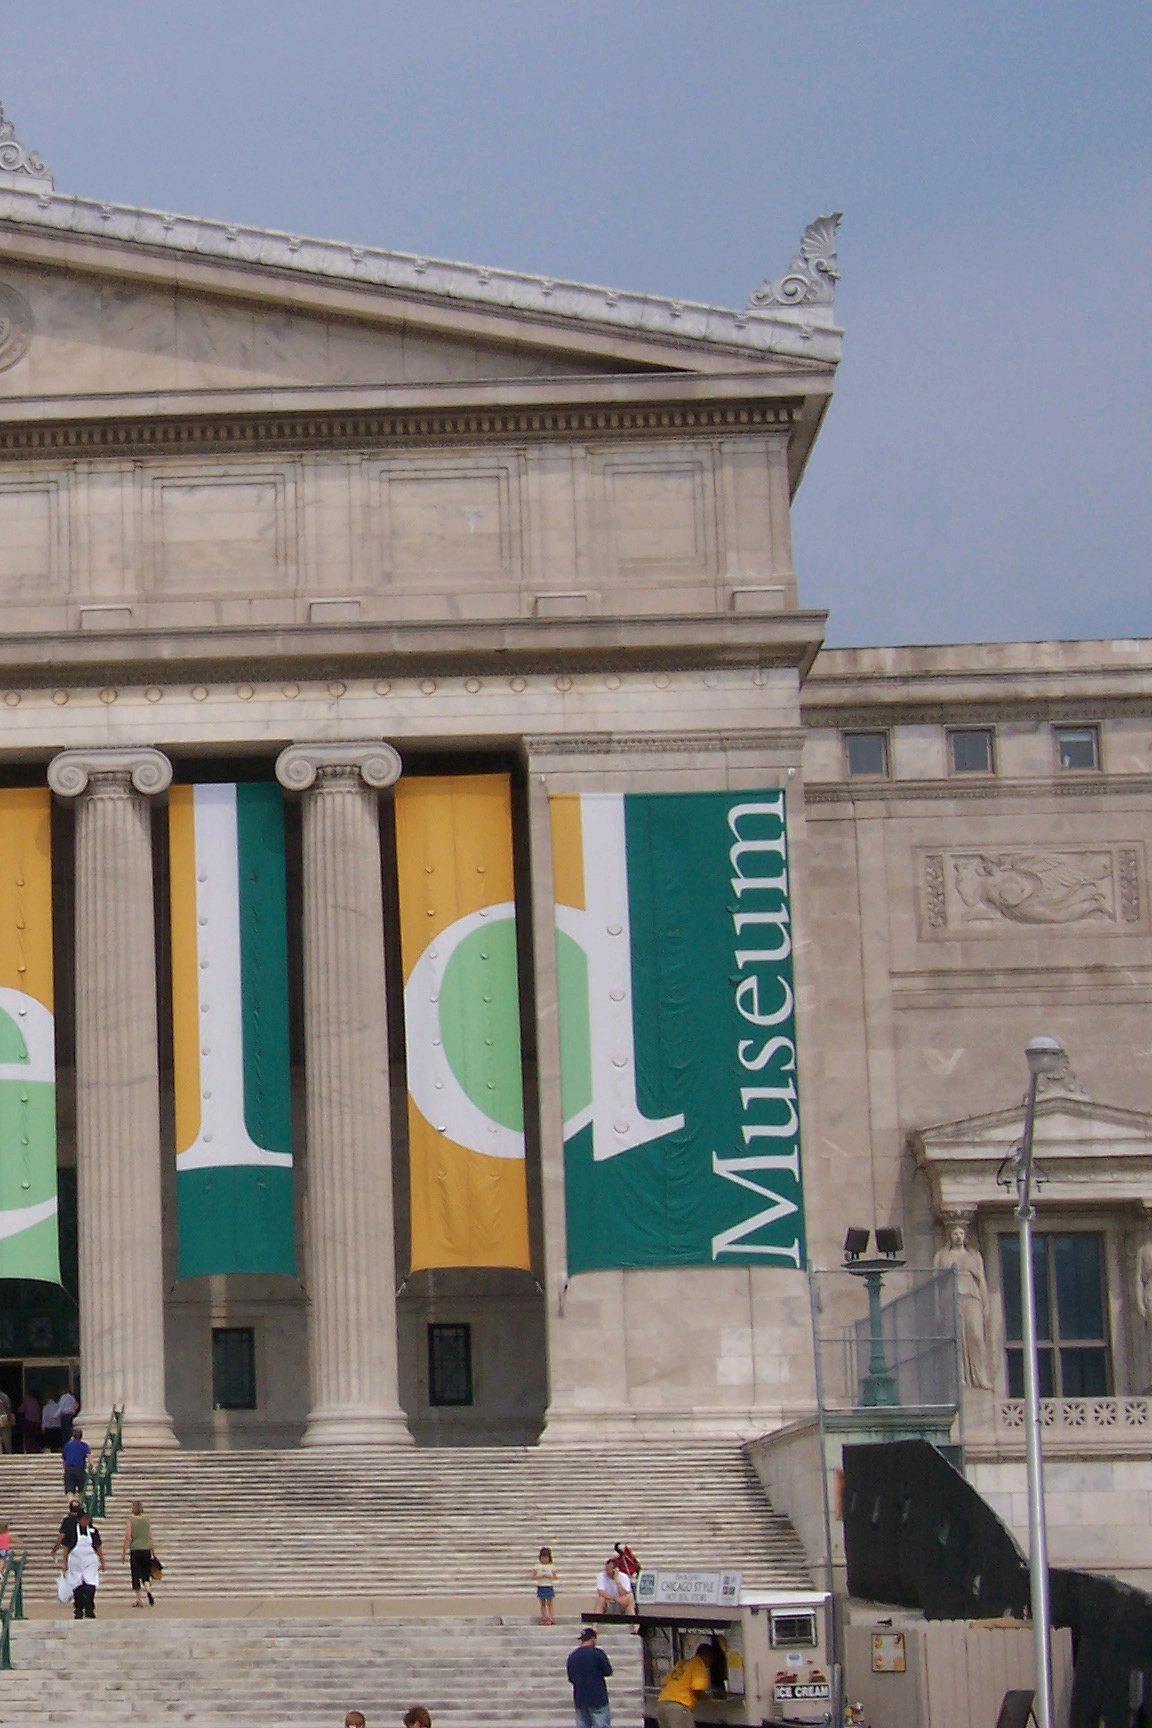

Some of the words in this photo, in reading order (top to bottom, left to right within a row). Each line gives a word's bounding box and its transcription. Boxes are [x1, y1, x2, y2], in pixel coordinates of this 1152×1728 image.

[710, 792, 802, 1269] Museum
[660, 1580, 693, 1592] CHICAGO
[694, 1581, 714, 1593] STYLE
[776, 1685, 793, 1698] ICE
[794, 1685, 830, 1698] CREAM
